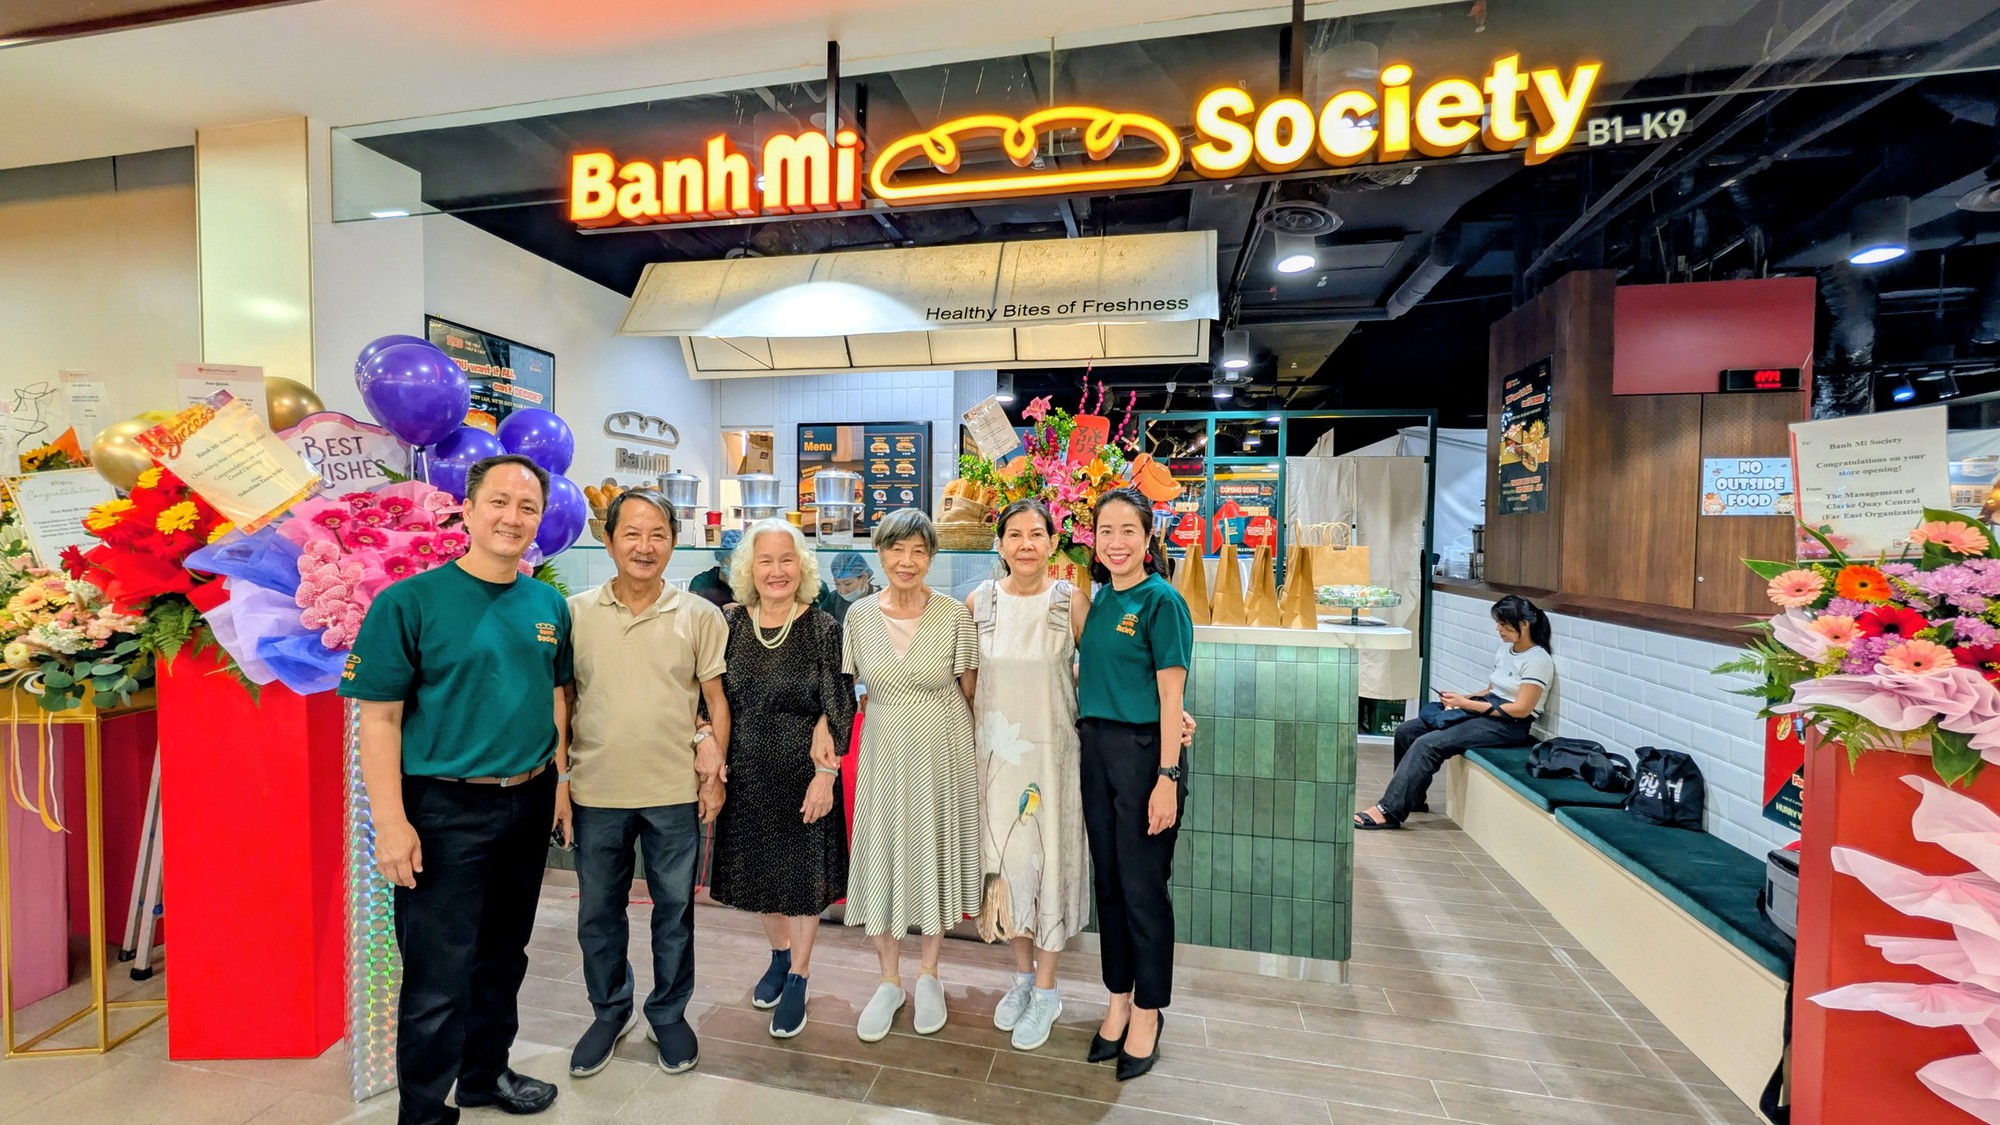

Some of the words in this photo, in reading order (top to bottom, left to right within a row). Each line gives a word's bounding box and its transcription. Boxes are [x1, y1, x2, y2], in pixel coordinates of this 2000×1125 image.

[1588, 109, 1687, 147] B1-K9
[569, 134, 757, 224] Banh
[1191, 54, 1602, 175] Society
[926, 306, 997, 322] Healthy
[1003, 302, 1050, 317] Bites
[1057, 301, 1077, 314] of
[1082, 297, 1189, 313] Freshness
[468, 363, 492, 376] want
[501, 367, 516, 380] ALL
[493, 382, 513, 395] can't
[514, 386, 544, 404] DECIDE?
[158, 408, 216, 461] Success
[1075, 426, 1103, 454] 發
[299, 436, 363, 464] BEST
[803, 441, 833, 452] Menu
[1829, 442, 1852, 450] Banh
[1870, 437, 1903, 446] Society
[1739, 460, 1763, 474] NO
[1816, 457, 1888, 469] Congratulations
[1904, 454, 1926, 463] your
[1862, 465, 1902, 476] opening!
[1220, 485, 1241, 494] COMING
[1242, 485, 1259, 494] SOON
[1715, 477, 1785, 490] OUTSIDE
[1727, 493, 1772, 507] FOOD
[1844, 489, 1903, 499] Management
[1826, 502, 1856, 510] Clarke
[1858, 500, 1882, 509] Quay
[1885, 498, 1921, 506] Central
[1843, 511, 1862, 519] East
[1048, 563, 1076, 580] 開業
[1116, 625, 1136, 637] Society
[537, 635, 557, 645] Society
